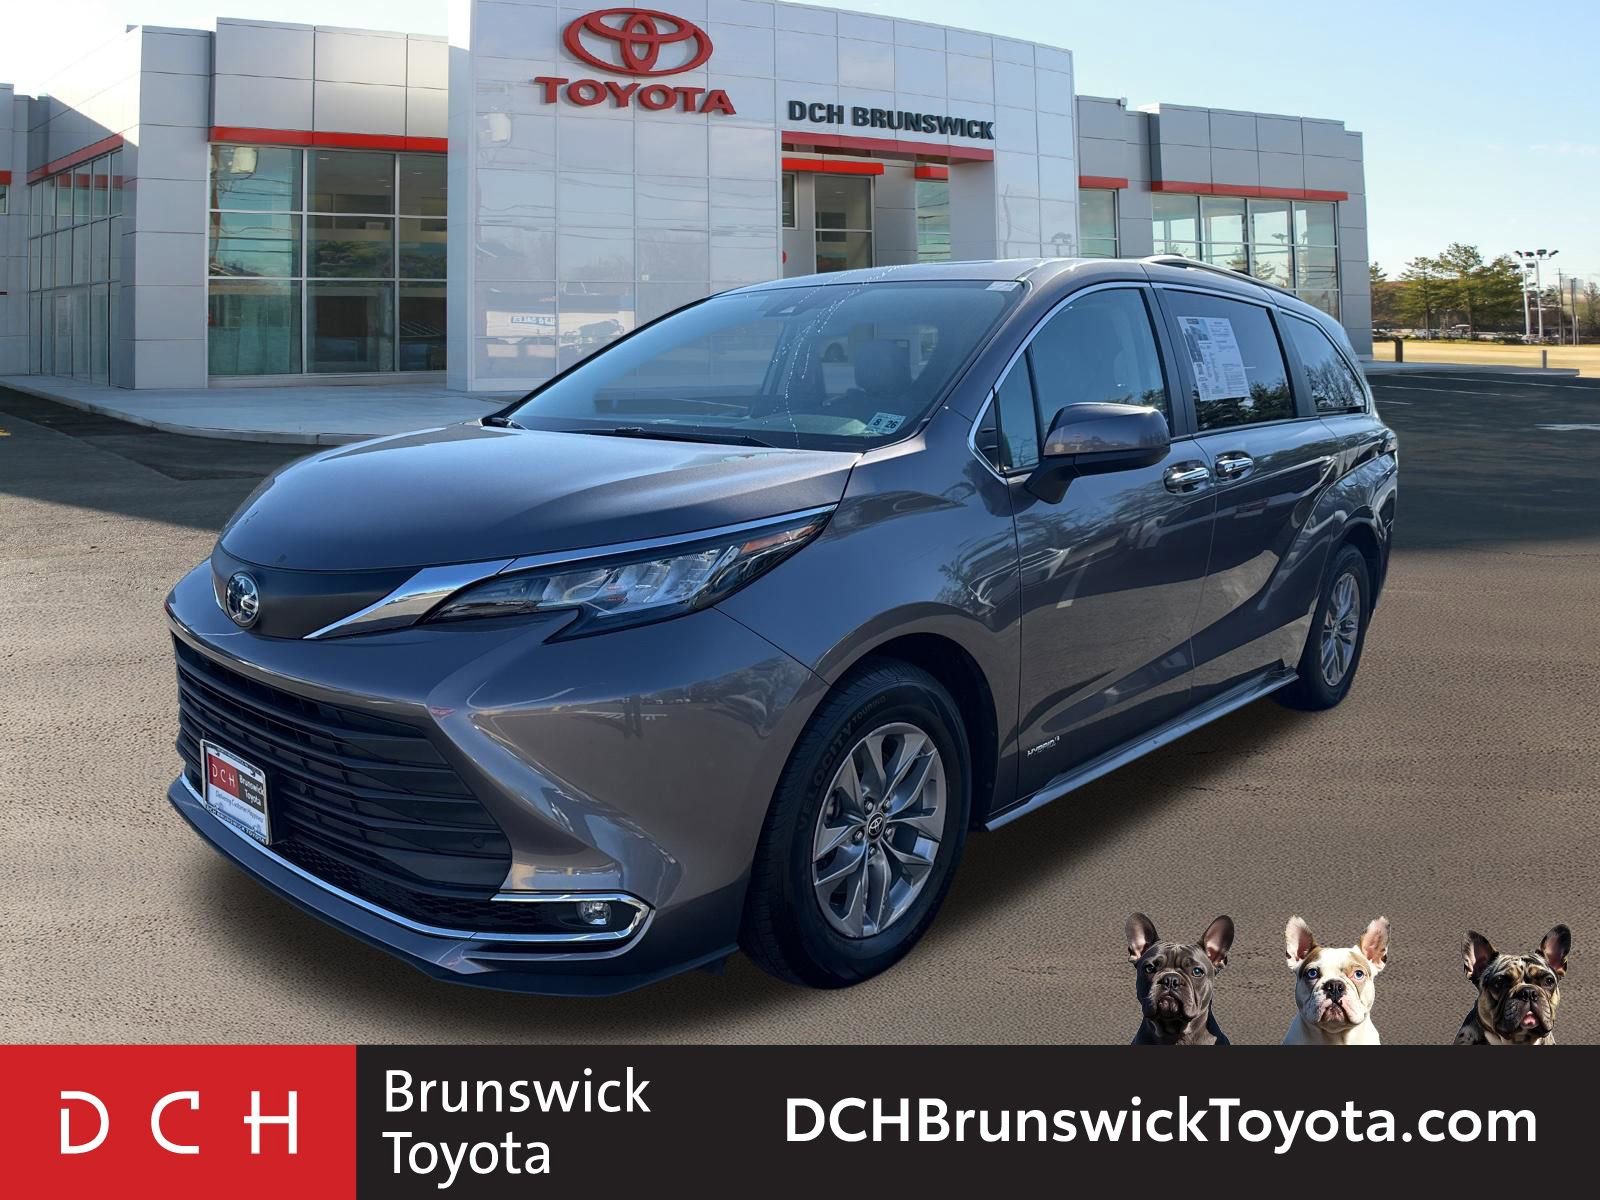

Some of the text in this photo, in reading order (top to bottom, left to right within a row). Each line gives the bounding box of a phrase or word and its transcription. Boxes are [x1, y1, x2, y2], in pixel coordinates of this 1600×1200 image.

[534, 76, 737, 115] TOYOTA
[788, 100, 995, 140] DCH BRUNSWICK
[211, 763, 236, 788] DCH
[245, 788, 262, 806] Toyota
